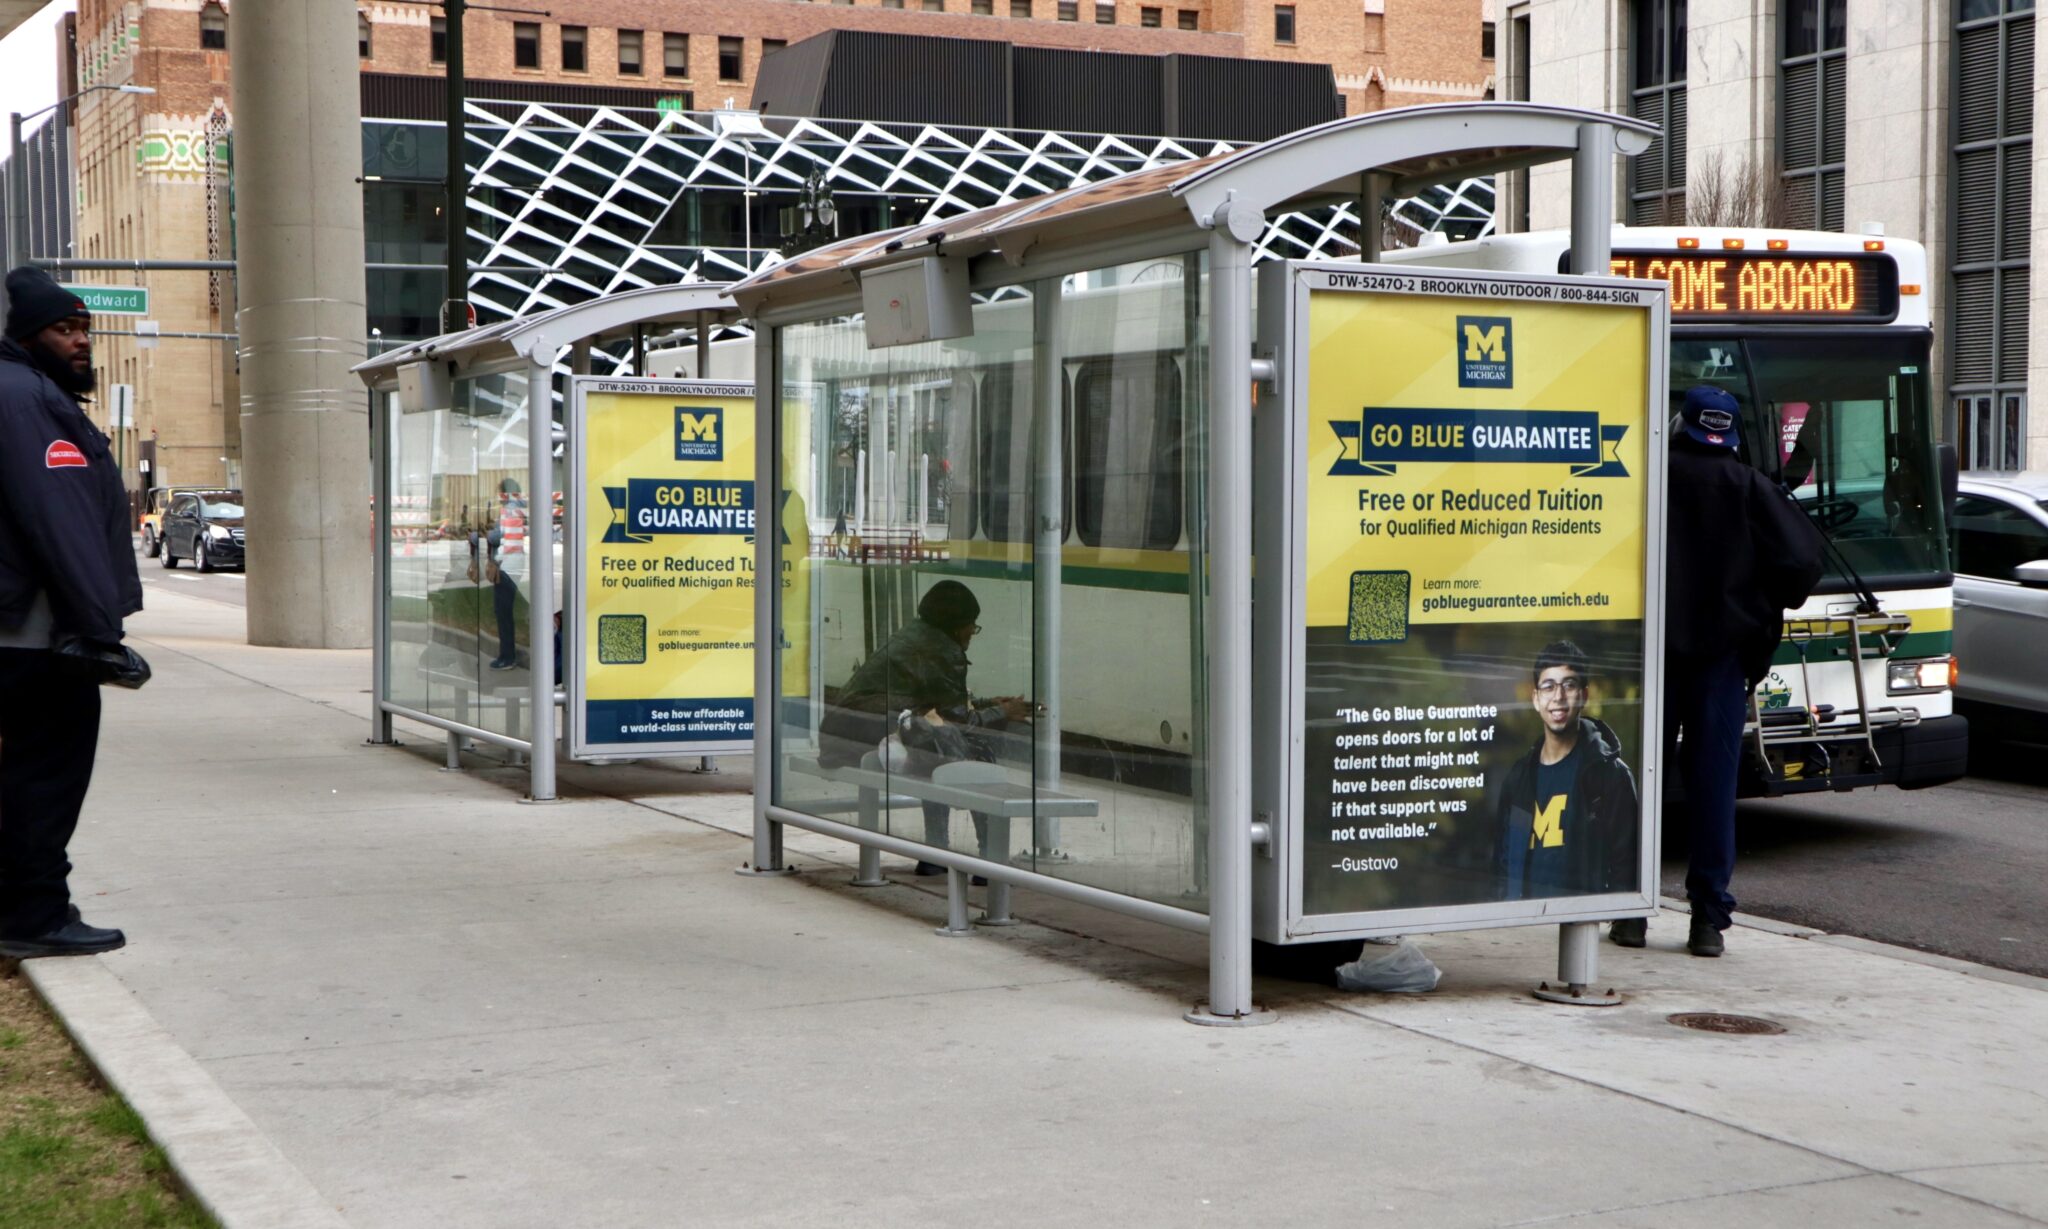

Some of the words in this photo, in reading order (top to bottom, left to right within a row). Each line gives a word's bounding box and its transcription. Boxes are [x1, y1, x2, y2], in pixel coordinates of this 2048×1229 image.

[1421, 280, 1487, 296] BROOKLYN
[1490, 283, 1551, 298] OUTDOOR
[1560, 286, 1639, 303] 800-844-SIGN
[1738, 261, 1855, 311] ABOARD
[78, 293, 137, 308] odward
[1464, 325, 1505, 361] M
[1466, 364, 1498, 372] UNIVERSITY
[1467, 370, 1505, 379] MICHIGAN
[659, 385, 704, 394] BROOKLYN
[704, 386, 745, 395] OUTDOOR
[681, 413, 717, 441] M
[1371, 424, 1402, 447] GO
[1412, 425, 1464, 447] BLUE
[1473, 426, 1591, 449] GUARANTEE
[656, 487, 684, 505] GO
[694, 488, 741, 506] BLUE
[1359, 490, 1405, 511] Free
[1413, 494, 1434, 511] or
[1442, 489, 1530, 511] Reduced
[1538, 488, 1602, 510] Tuition
[1360, 519, 1381, 535] for
[1387, 519, 1455, 537] Qualified
[1460, 518, 1527, 538] Michigan
[1532, 518, 1601, 534] Residents
[602, 557, 636, 571] Free
[642, 560, 659, 571] or
[665, 556, 734, 571] Reduced
[602, 576, 618, 587] for
[622, 576, 675, 589] Qualified
[679, 576, 732, 590] Michigan
[1423, 579, 1450, 589] Learn
[1454, 580, 1482, 590] more:
[1423, 592, 1608, 612] goblueguarantee.umich.edu
[652, 710, 669, 719] See
[672, 710, 692, 718] how
[694, 709, 744, 718] affordable
[1337, 708, 1369, 723] “The
[1373, 708, 1391, 721] Go
[1395, 706, 1424, 720] Blue
[1427, 705, 1497, 719] Guarantee
[630, 723, 686, 732] world-class
[688, 721, 736, 732] university
[1336, 734, 1378, 749] opens
[1383, 731, 1421, 745] doors
[1425, 728, 1444, 743] for
[1448, 731, 1455, 742] a
[1460, 728, 1477, 741] lot
[1481, 726, 1494, 740] of
[1334, 755, 1377, 770] talent
[1381, 754, 1410, 768] that
[1415, 751, 1453, 769] might
[1457, 751, 1479, 765] not
[1333, 779, 1367, 793] have
[1371, 778, 1406, 792] been
[1410, 773, 1483, 790] discovered
[1332, 802, 1342, 817] if
[1346, 802, 1376, 816] that
[1380, 800, 1435, 817] support
[1439, 800, 1466, 812] was
[1530, 794, 1568, 849] M
[1332, 827, 1355, 841] not
[1359, 822, 1437, 839] available.”
